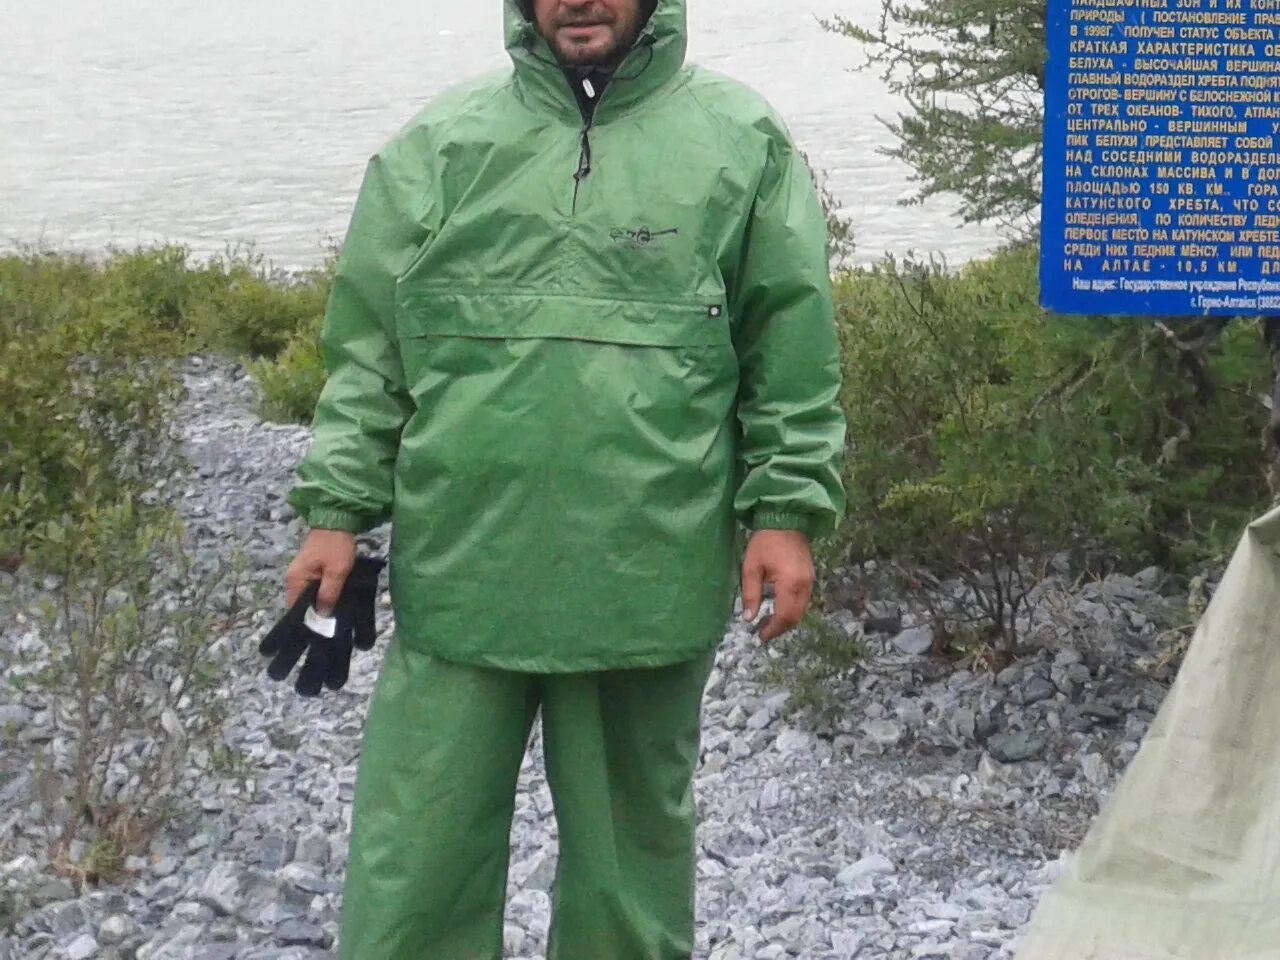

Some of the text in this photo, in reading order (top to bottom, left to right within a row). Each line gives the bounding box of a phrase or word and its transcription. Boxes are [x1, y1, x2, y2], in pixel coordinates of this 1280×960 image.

[1071, 9, 1124, 23] ПРИРОДЫ
[1153, 11, 1246, 24] ПОСТАНОВЛЕНИЕ
[1070, 25, 1077, 36] В
[1124, 27, 1174, 38] ПОЛУЧЕН
[1180, 27, 1219, 39] СТАТУС
[1224, 28, 1274, 40] ОБЪЕКТА
[1070, 40, 1127, 53] КРАТКАЯ
[1137, 42, 1255, 56] ХАРАКТЕРИСТИКА
[1069, 57, 1113, 69] БЕЛУХА
[1135, 57, 1217, 71] ВЫСОЧАЙШАЯ
[1226, 60, 1280, 72] ВЕРШИНА
[1069, 72, 1121, 85] ГЛАВНЫЙ
[1124, 74, 1195, 87] ВОДОРАЗДЕЛ
[1198, 75, 1238, 86] ХРЕБТА
[1124, 89, 1177, 101] ВЕРШИНУ
[1179, 90, 1186, 101] С
[1189, 90, 1272, 103] БЕЛОСНЕЖНОЙ
[1068, 103, 1082, 115] ОТ
[1092, 104, 1118, 117] ТРЕХ
[1192, 106, 1236, 118] ТИХОГО,
[1067, 119, 1147, 132] ЦЕНТРАЛЬНО
[1168, 120, 1247, 133] ВЕРШИННЫМ
[1067, 134, 1088, 146] ПИК
[1096, 135, 1137, 147] БЕЛУХИ
[1145, 135, 1228, 148] ПРЕДСТАВЛЯЕТ
[1235, 136, 1272, 149] СОБОЙ
[1066, 150, 1092, 163] НАД
[1102, 151, 1181, 164] СОСЕДНИМИ
[1066, 166, 1081, 177] НА
[1092, 166, 1148, 178] СКЛОНАХ
[1158, 167, 1216, 178] МАССИВА
[1225, 167, 1232, 178] И
[1242, 168, 1249, 179] В
[1066, 181, 1140, 195] ПЛОЩАДЬЮ
[1150, 183, 1169, 194] 150
[1248, 184, 1278, 196] ГОРА
[1066, 197, 1151, 209] КАТУНСКОГО
[1169, 199, 1223, 212] ХРЕБТА,
[1234, 200, 1258, 211] ЧТО
[1156, 214, 1171, 225] ПО
[1178, 214, 1247, 227] КОЛИЧЕСТВУ
[1065, 228, 1108, 241] ПЕРВОЕ
[1112, 228, 1149, 240] МЕСТО
[1152, 229, 1168, 240] НА
[1172, 229, 1234, 242] КАТУНСКОМ
[1064, 243, 1100, 257] СРЕДИ
[1106, 244, 1127, 256] НИХ
[1133, 245, 1175, 258] ЛЕДНИК
[1231, 246, 1252, 257] ИЛИ
[1064, 259, 1082, 271] НА
[1102, 260, 1150, 272] АЛТАЕ
[1178, 261, 1207, 274] 10,5
